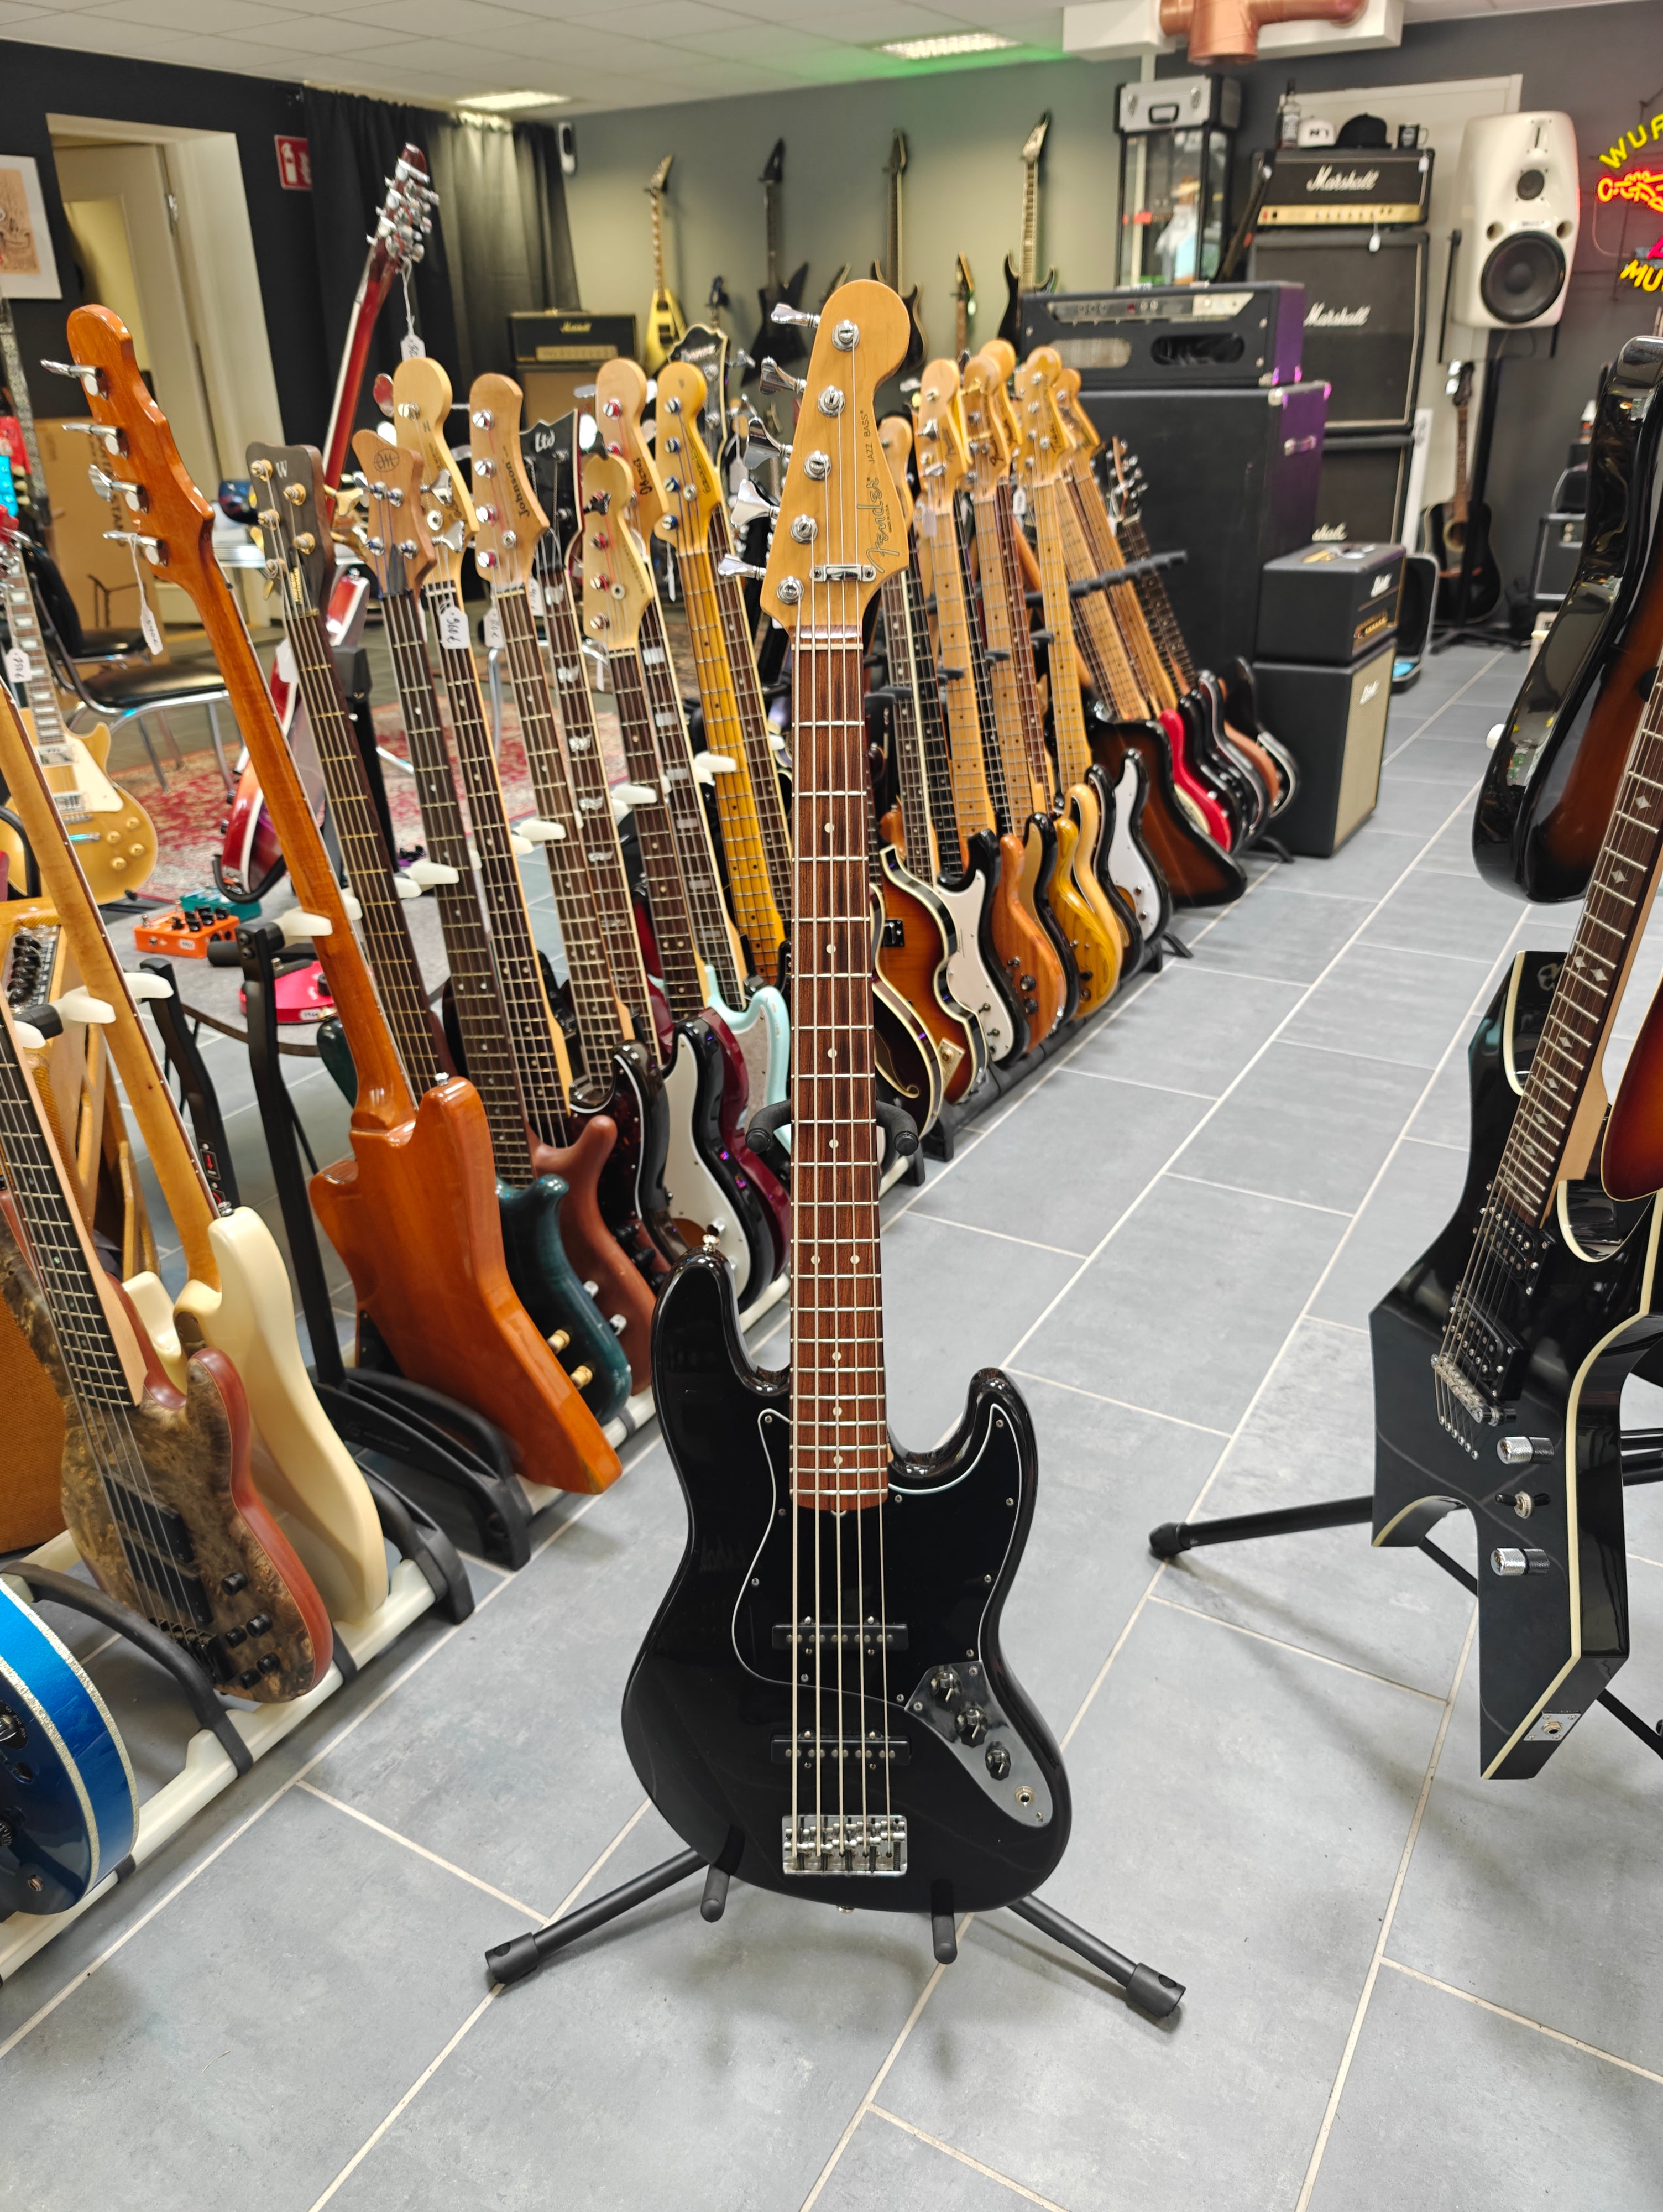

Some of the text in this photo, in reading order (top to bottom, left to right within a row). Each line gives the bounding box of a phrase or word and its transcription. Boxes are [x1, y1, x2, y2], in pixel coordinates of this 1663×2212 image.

[1306, 165, 1380, 191] Marshall
[1620, 259, 1663, 292] MU
[1303, 301, 1371, 327] Marshall
[865, 444, 875, 464] JAZZ
[505, 461, 530, 519] Johnson
